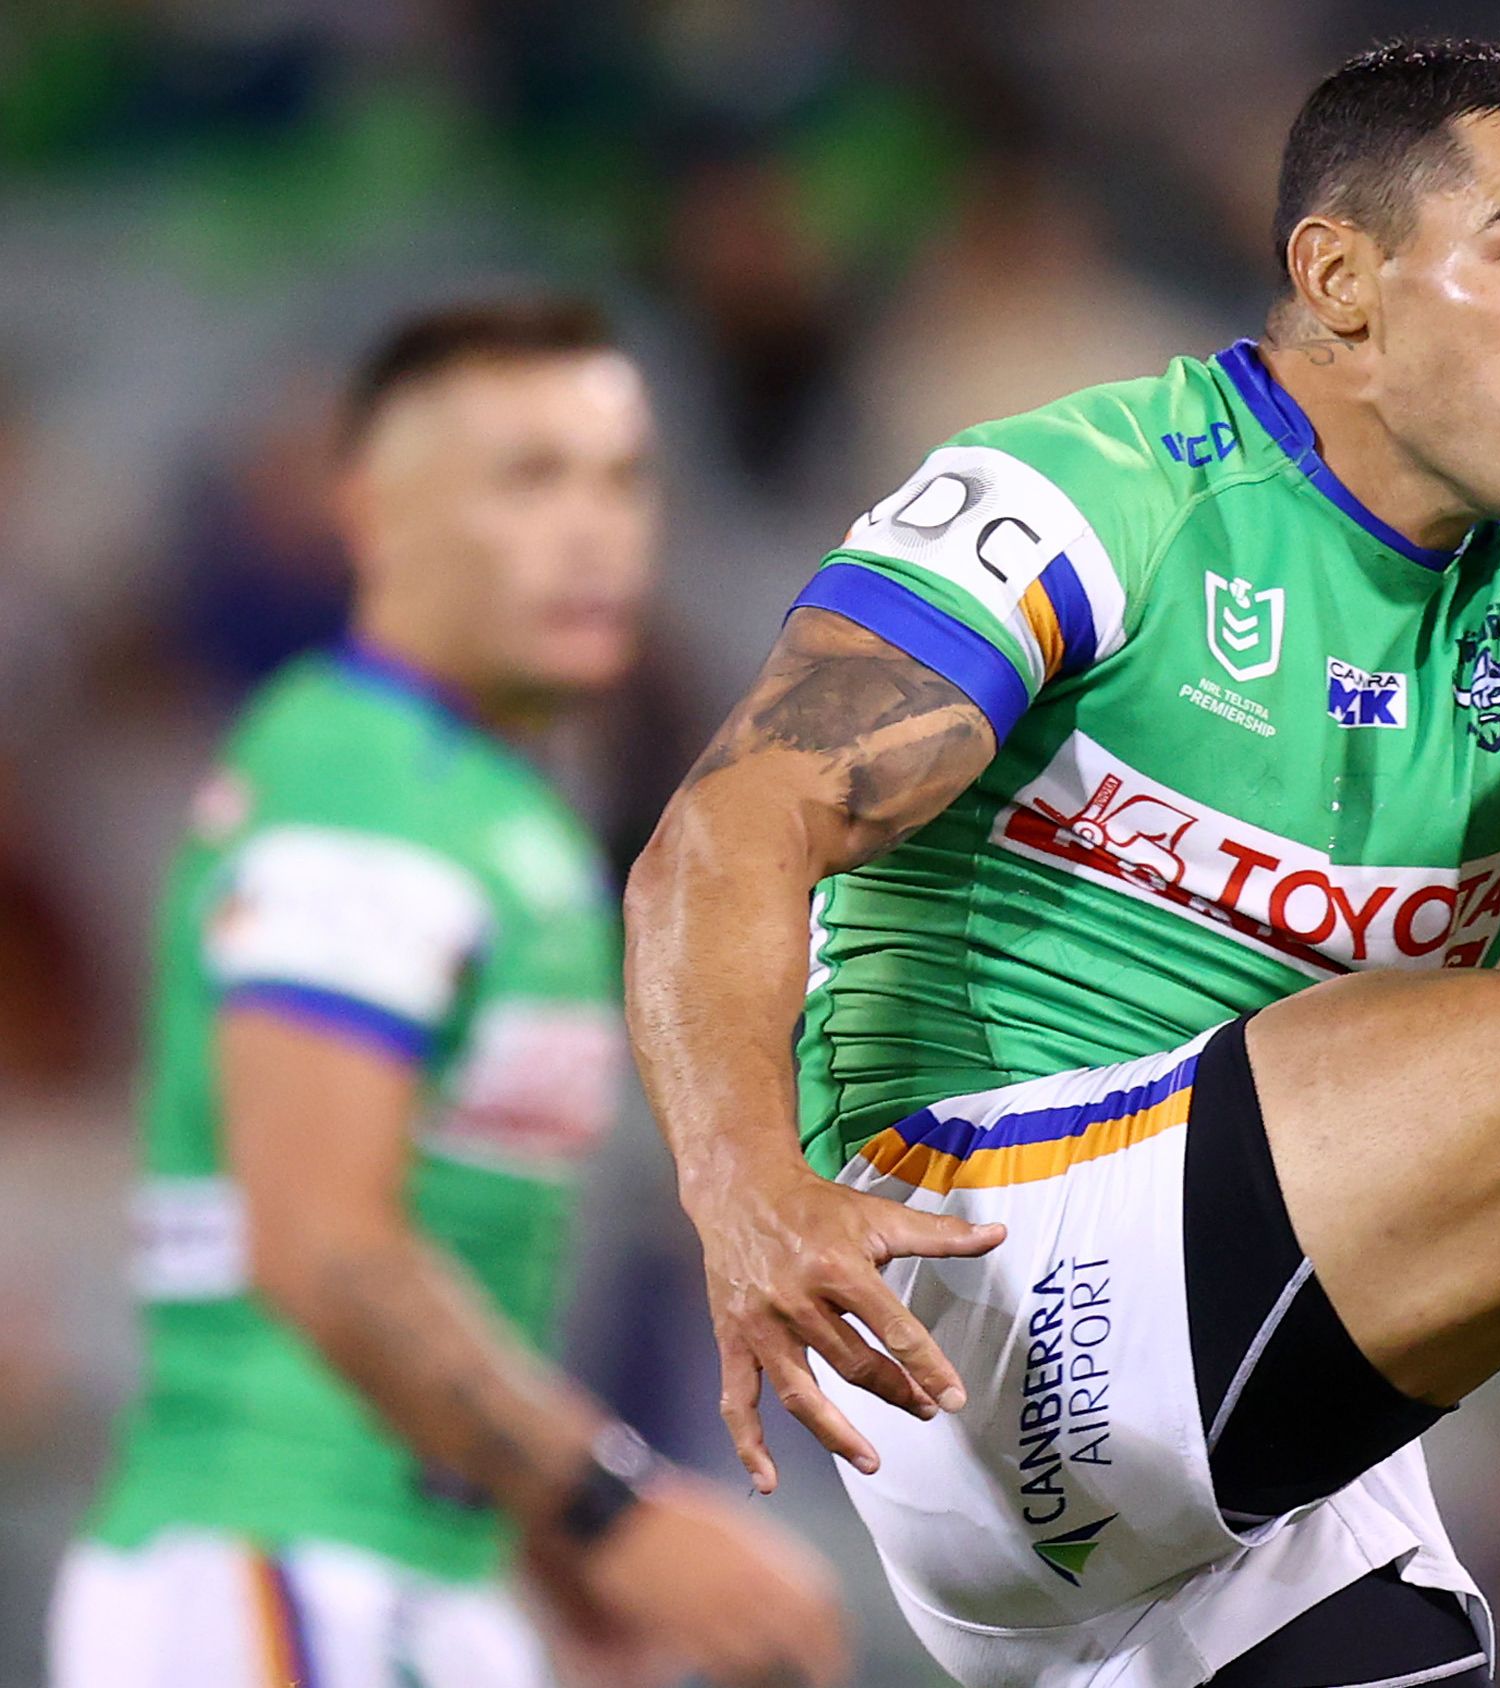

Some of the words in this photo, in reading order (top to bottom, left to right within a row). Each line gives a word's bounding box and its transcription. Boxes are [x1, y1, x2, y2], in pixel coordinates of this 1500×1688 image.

[868, 472, 1042, 584] DC
[1179, 684, 1277, 738] PREMIERSHIP
[1198, 678, 1222, 699] NRL
[1223, 689, 1269, 720] TELSTRA
[1018, 1259, 1067, 1525] CANBERRA
[1069, 1256, 1112, 1465] AIRPORT
